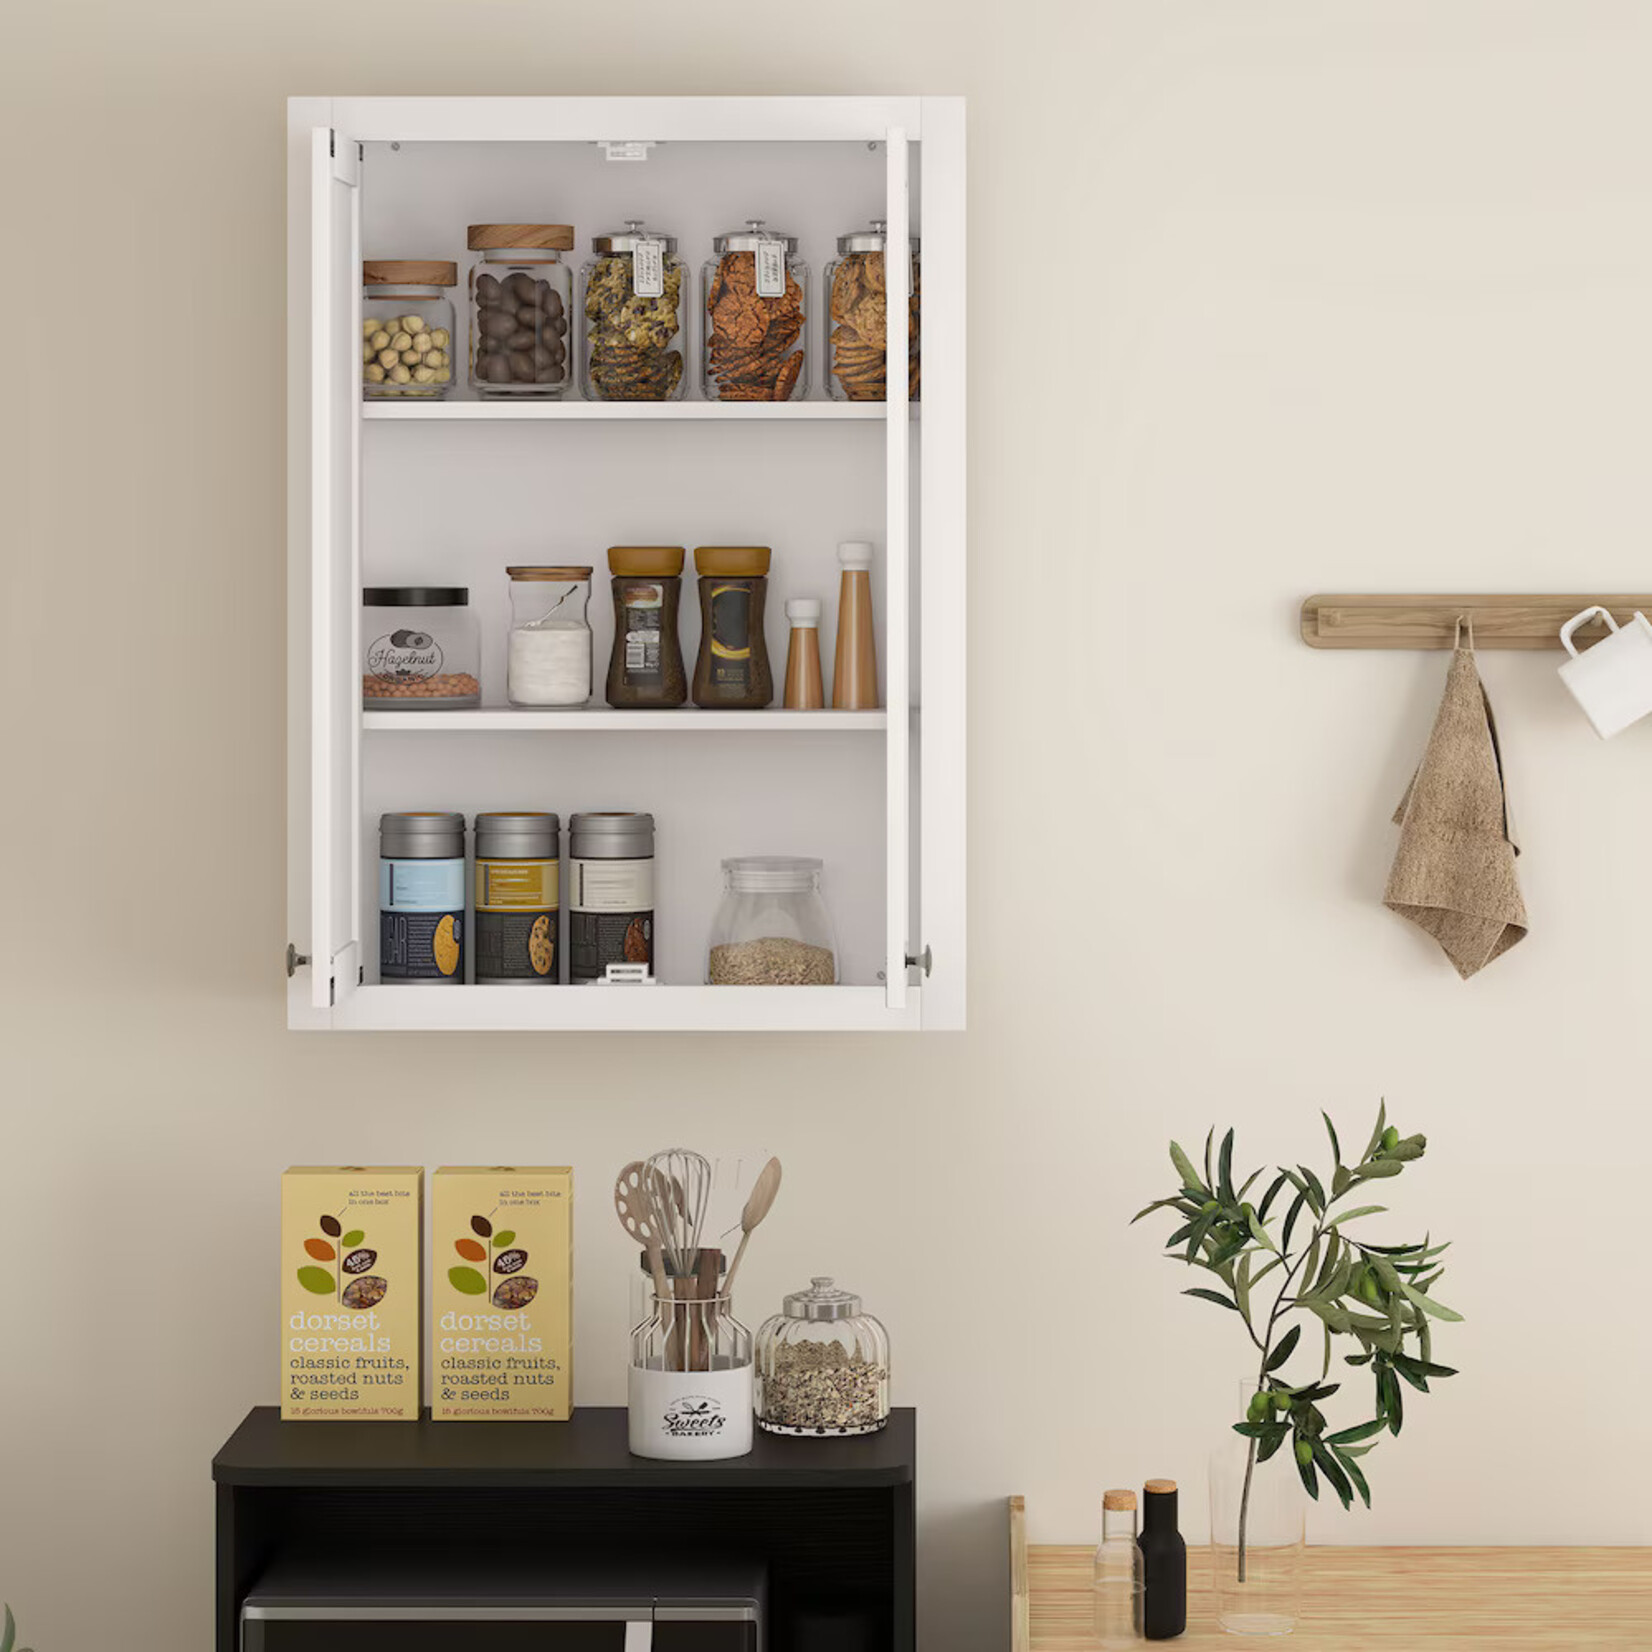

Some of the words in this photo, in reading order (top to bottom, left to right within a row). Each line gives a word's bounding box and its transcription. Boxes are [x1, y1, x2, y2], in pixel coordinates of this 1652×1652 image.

[368, 649, 436, 668] Hazelnut
[290, 1311, 380, 1331] dorset
[440, 1311, 532, 1331] dorset
[290, 1333, 391, 1352] cereals
[440, 1333, 542, 1352] cereals
[290, 1356, 351, 1369] classic
[356, 1356, 409, 1371] fruits,
[440, 1357, 501, 1369] classic
[506, 1357, 560, 1371] fruits,
[290, 1372, 357, 1385] roasted
[363, 1373, 403, 1385] nuts
[440, 1372, 508, 1385] roasted
[513, 1374, 554, 1385] nuts
[290, 1387, 305, 1400] &
[310, 1387, 359, 1400] seeds
[440, 1387, 457, 1400] &
[460, 1387, 510, 1400] seeds
[302, 1407, 339, 1416] glorious
[380, 1407, 404, 1416] 700g
[531, 1407, 554, 1416] 700g
[662, 1413, 726, 1432] Sweets
